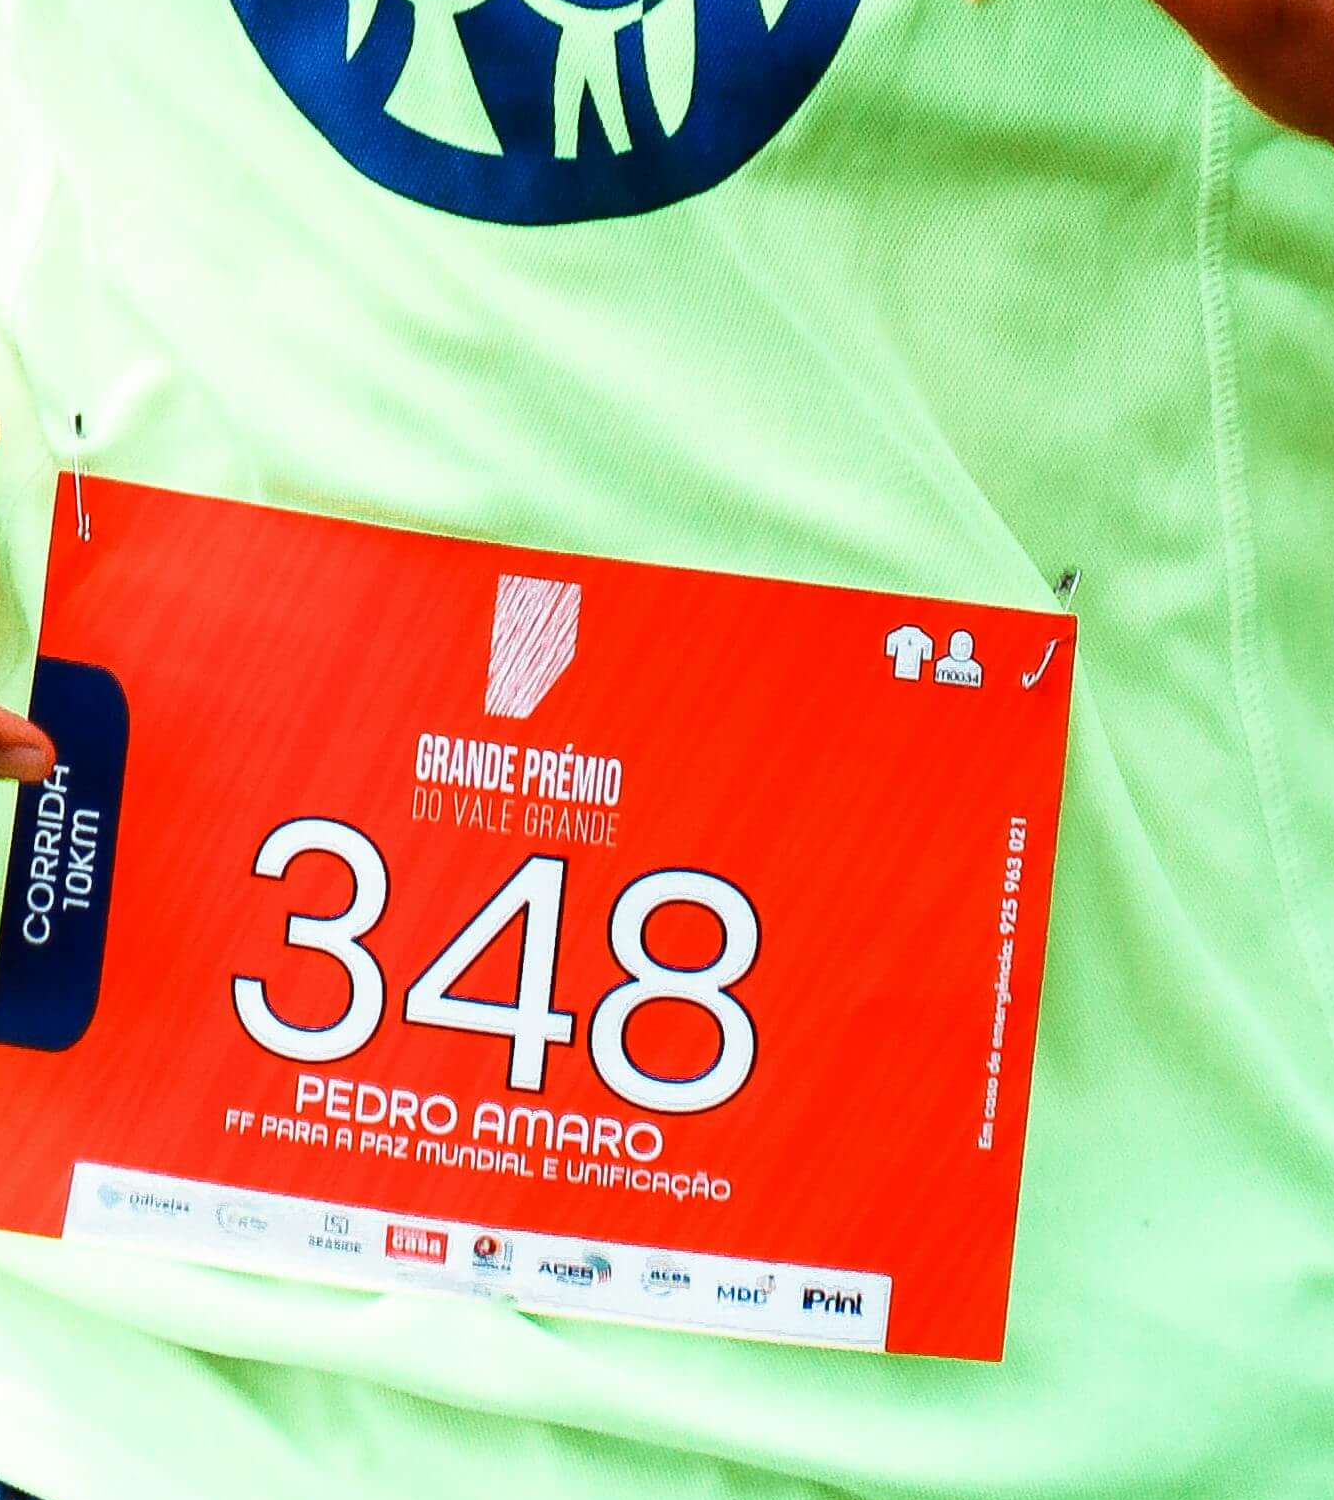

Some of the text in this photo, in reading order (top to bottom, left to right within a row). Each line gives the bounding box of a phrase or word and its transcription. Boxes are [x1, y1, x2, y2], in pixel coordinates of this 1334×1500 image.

[415, 732, 623, 807] GRANDE PRÉMIO
[412, 785, 621, 848] DO VALE GRANDE
[1008, 816, 1027, 853] 021
[22, 764, 70, 945] CORRIDA
[1004, 856, 1023, 892] 963
[999, 897, 1018, 935] 925
[230, 815, 762, 1117] 348
[987, 1051, 1002, 1075] de
[295, 1073, 665, 1162] PEDRO AMARO
[984, 1077, 999, 1120] caso
[224, 1108, 732, 1202] FF PARA A PAZ MUNDIAL E UNIFICAÇÃO
[978, 1122, 994, 1149] Em
